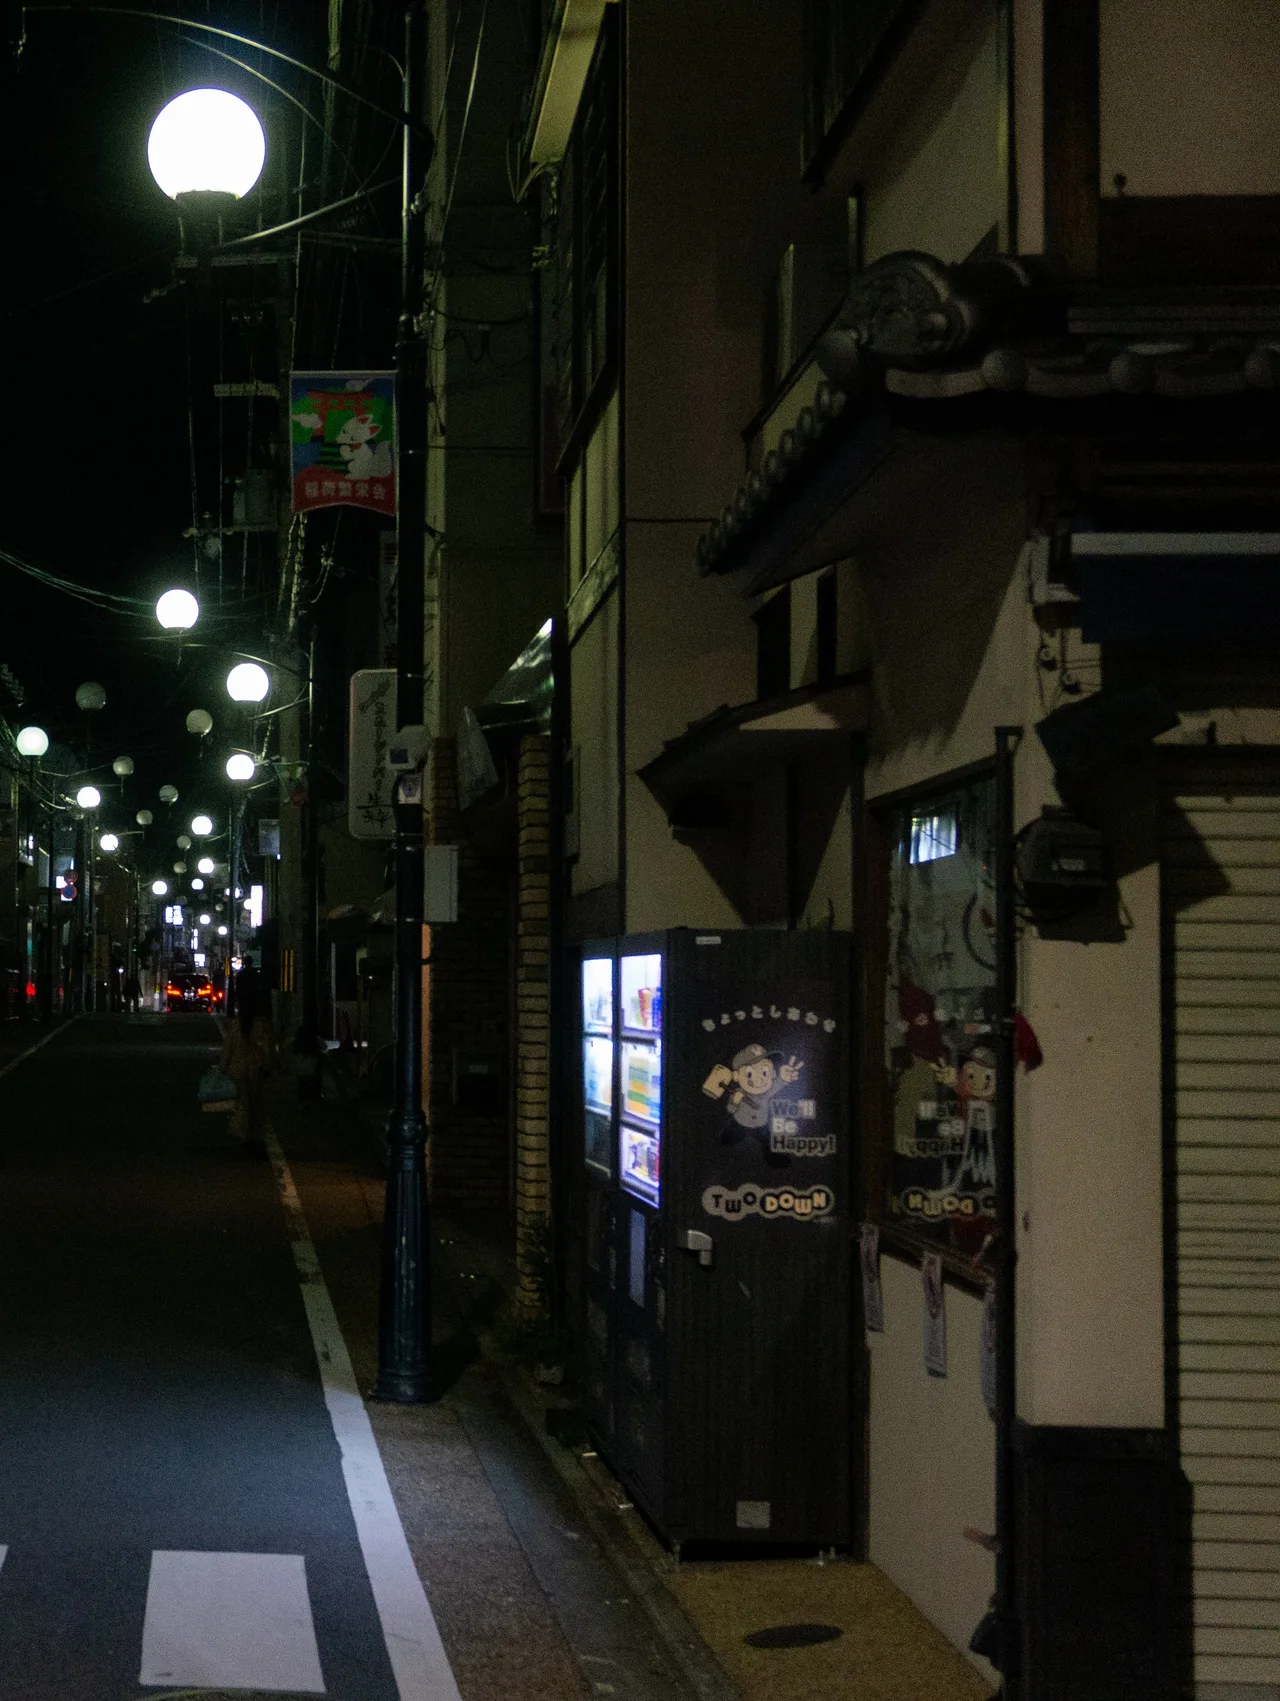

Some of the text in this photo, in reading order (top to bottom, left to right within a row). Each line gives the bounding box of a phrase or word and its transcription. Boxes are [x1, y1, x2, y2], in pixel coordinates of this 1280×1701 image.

[773, 1135, 835, 1154] Happy!
[711, 1191, 829, 1213] TWO DOWN
